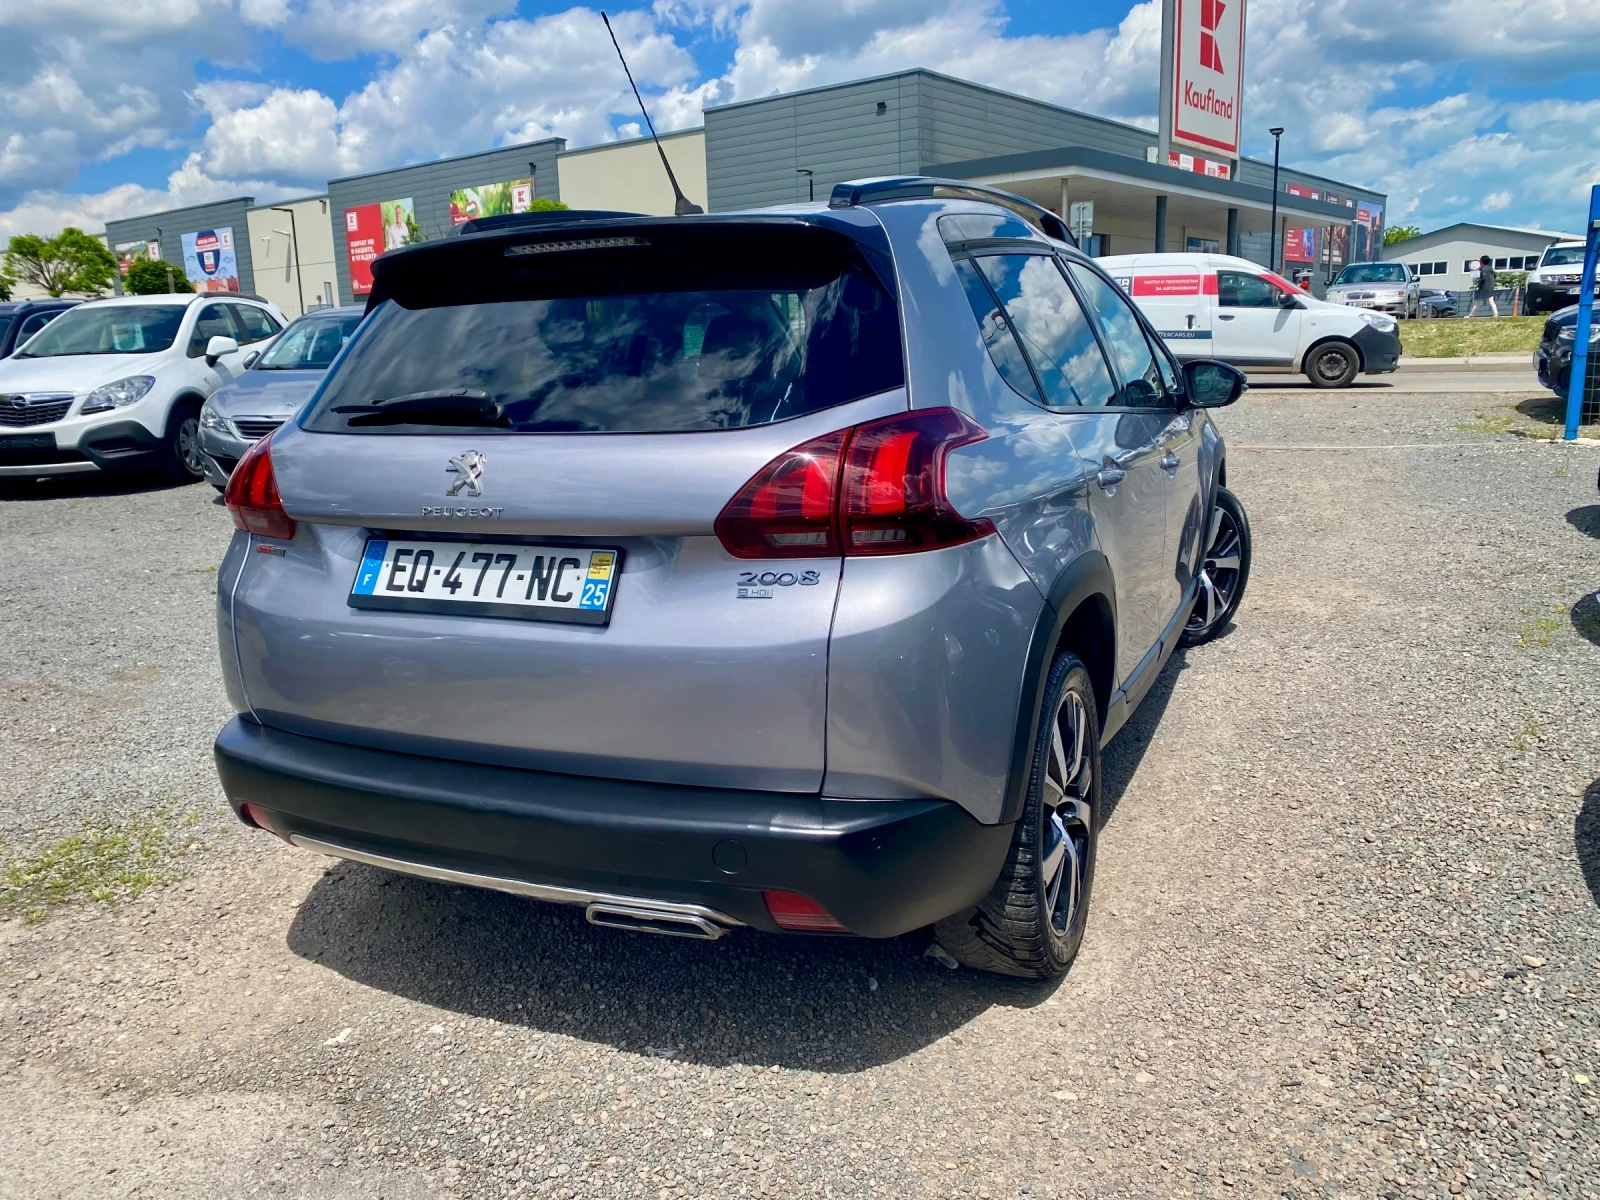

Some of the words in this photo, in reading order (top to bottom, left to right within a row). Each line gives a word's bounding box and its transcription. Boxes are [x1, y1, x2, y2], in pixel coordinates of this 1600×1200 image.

[1184, 79, 1233, 119] Kaufland
[421, 506, 505, 518] PEUGEOT
[362, 573, 373, 586] F
[385, 547, 581, 604] EQ-477-NC
[736, 569, 821, 587] 2008
[581, 583, 607, 606] 25
